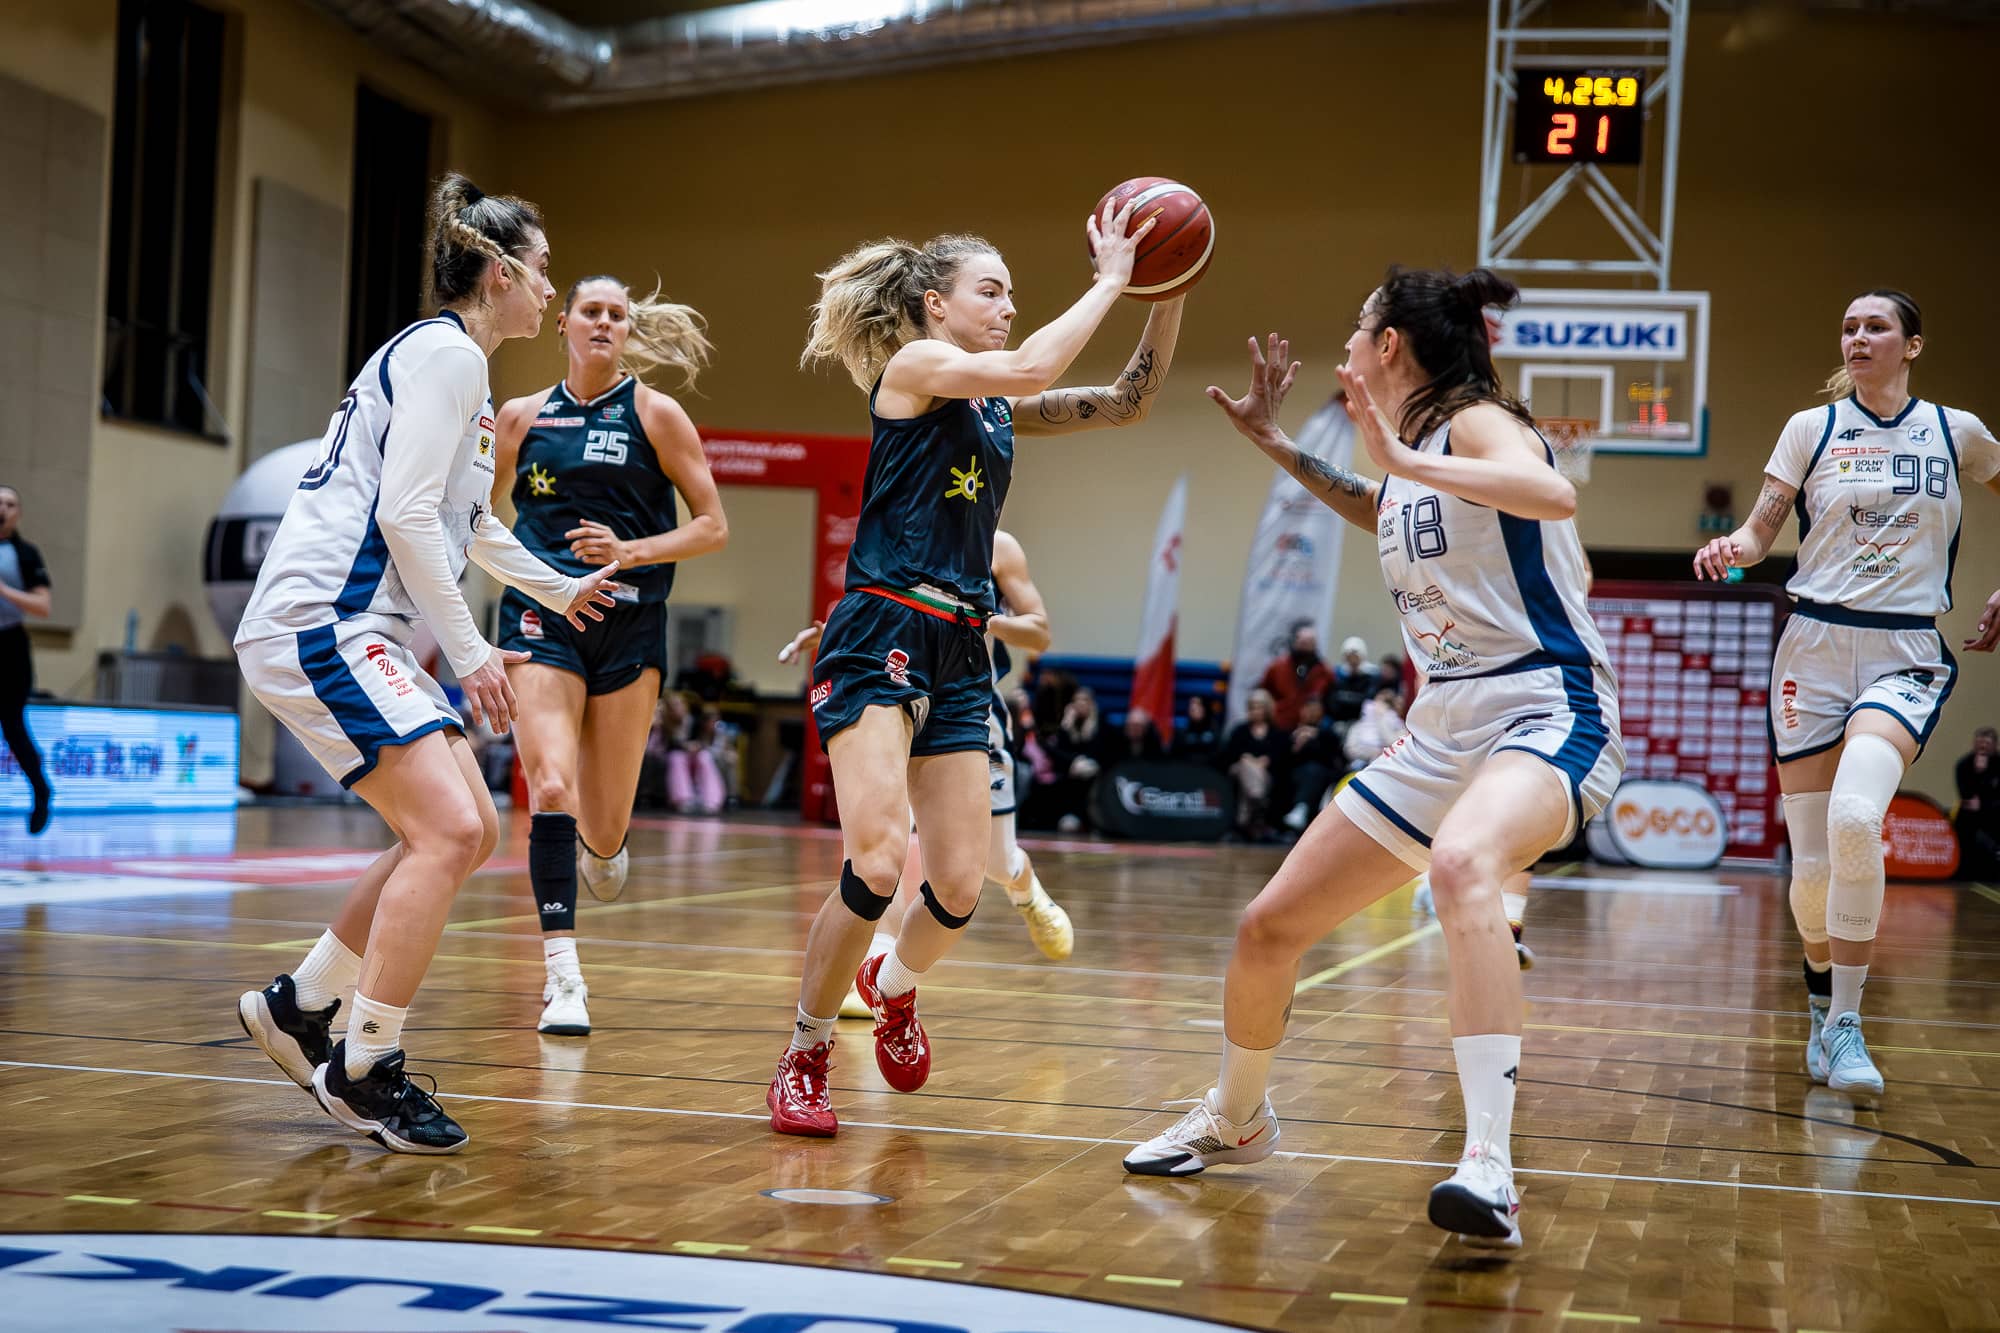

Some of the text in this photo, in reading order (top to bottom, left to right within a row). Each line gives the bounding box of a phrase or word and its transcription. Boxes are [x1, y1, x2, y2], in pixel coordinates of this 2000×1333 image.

[1515, 320, 1677, 348] SUZUKI
[583, 429, 630, 466] 25
[1838, 428, 1865, 440] 4F
[1892, 454, 1950, 499] 98
[1402, 495, 1448, 562] 18
[1896, 691, 1922, 706] 4F
